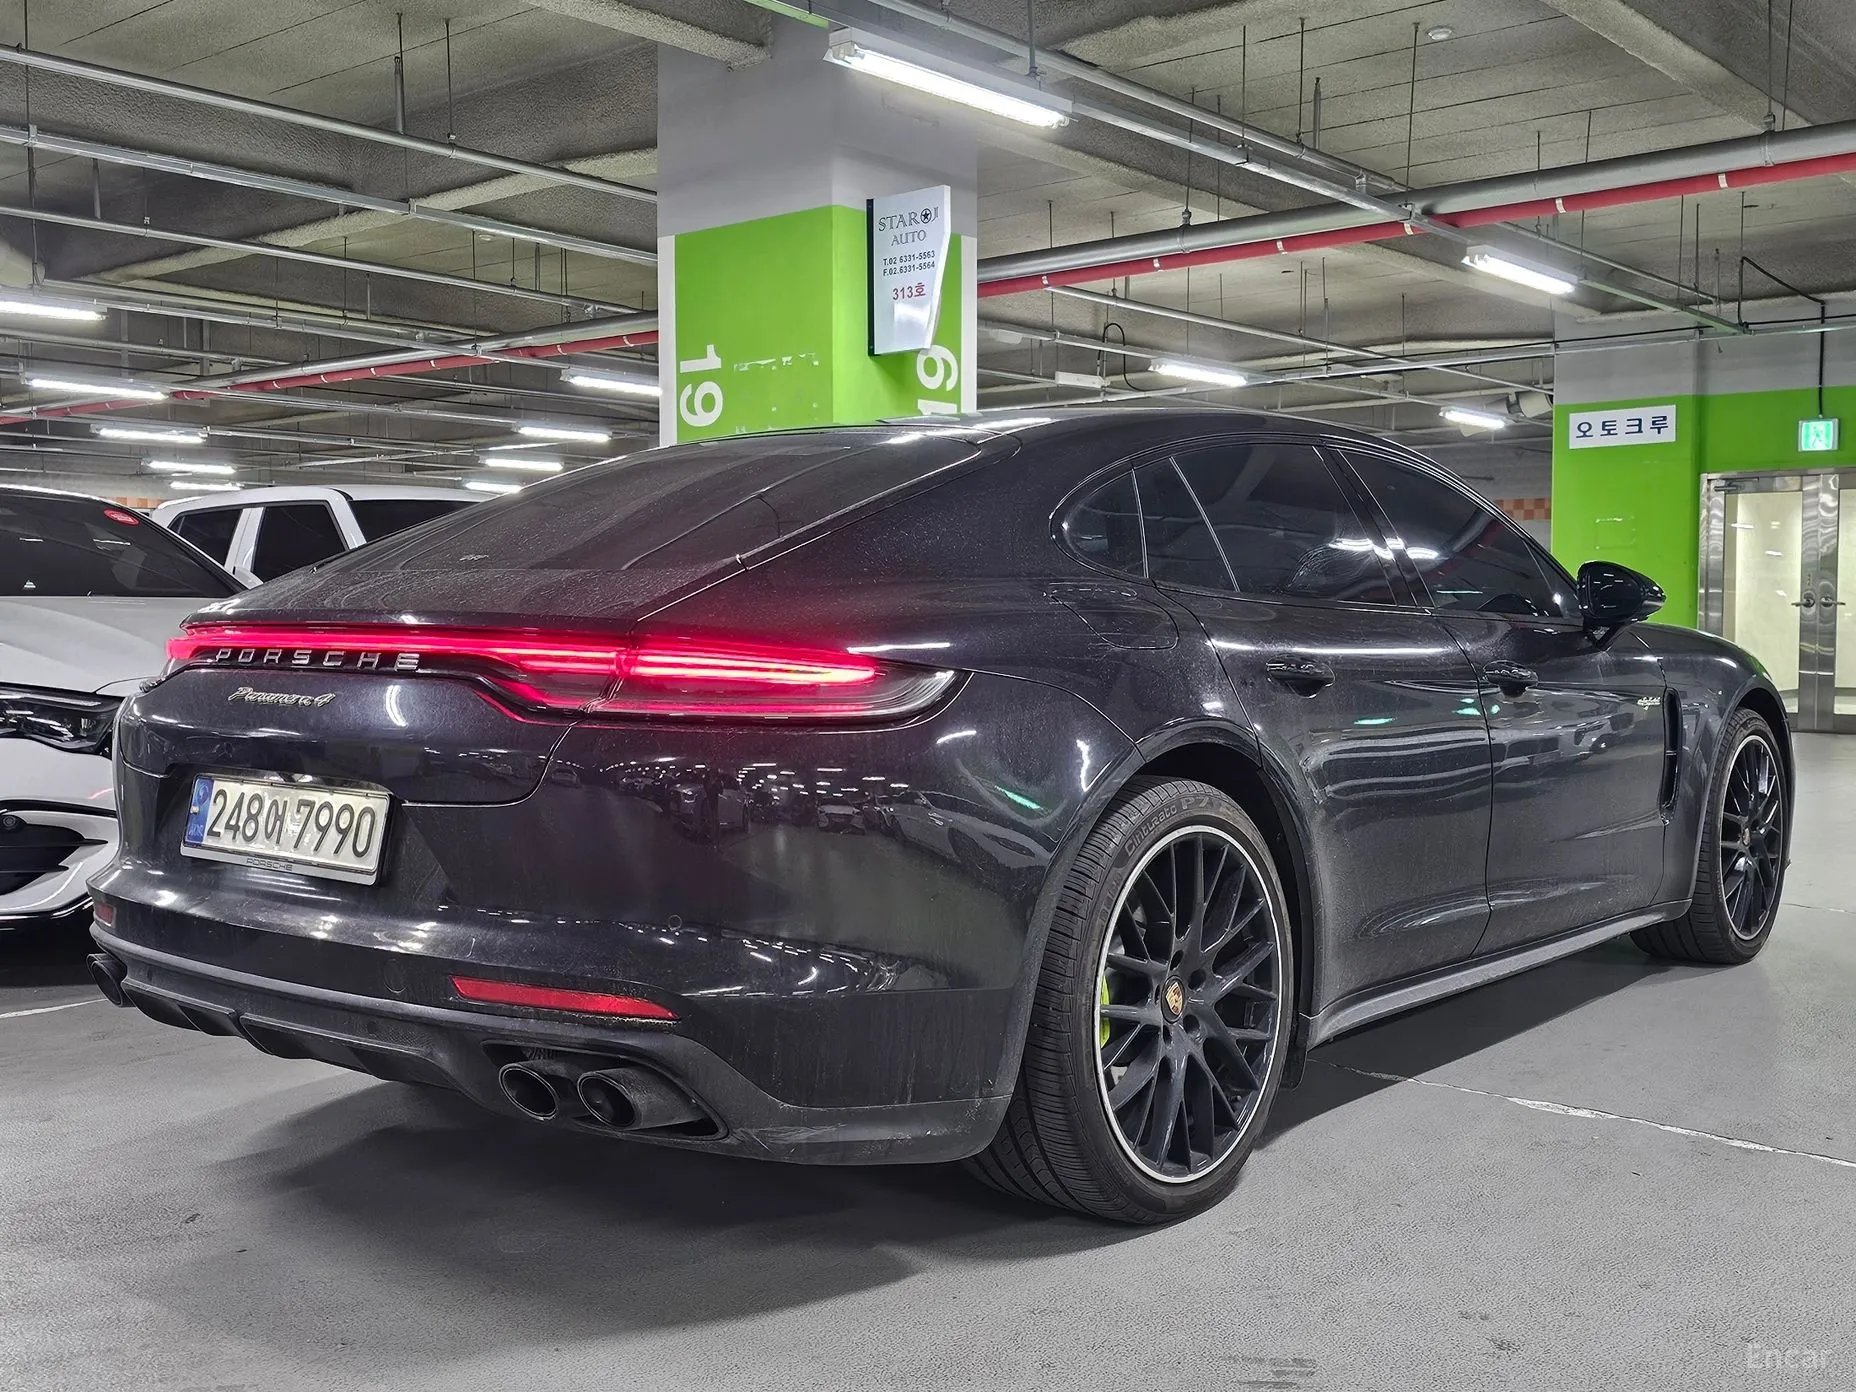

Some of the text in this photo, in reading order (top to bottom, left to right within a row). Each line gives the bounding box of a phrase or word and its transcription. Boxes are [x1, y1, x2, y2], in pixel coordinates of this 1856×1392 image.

[891, 229, 927, 247] AUTO
[892, 282, 926, 301] 313호
[680, 344, 724, 427] 19
[1575, 415, 1669, 439] 오토크루
[215, 648, 421, 671] PORSCHE
[228, 686, 336, 707] Panamera 4
[246, 857, 293, 871] PORSCHE
